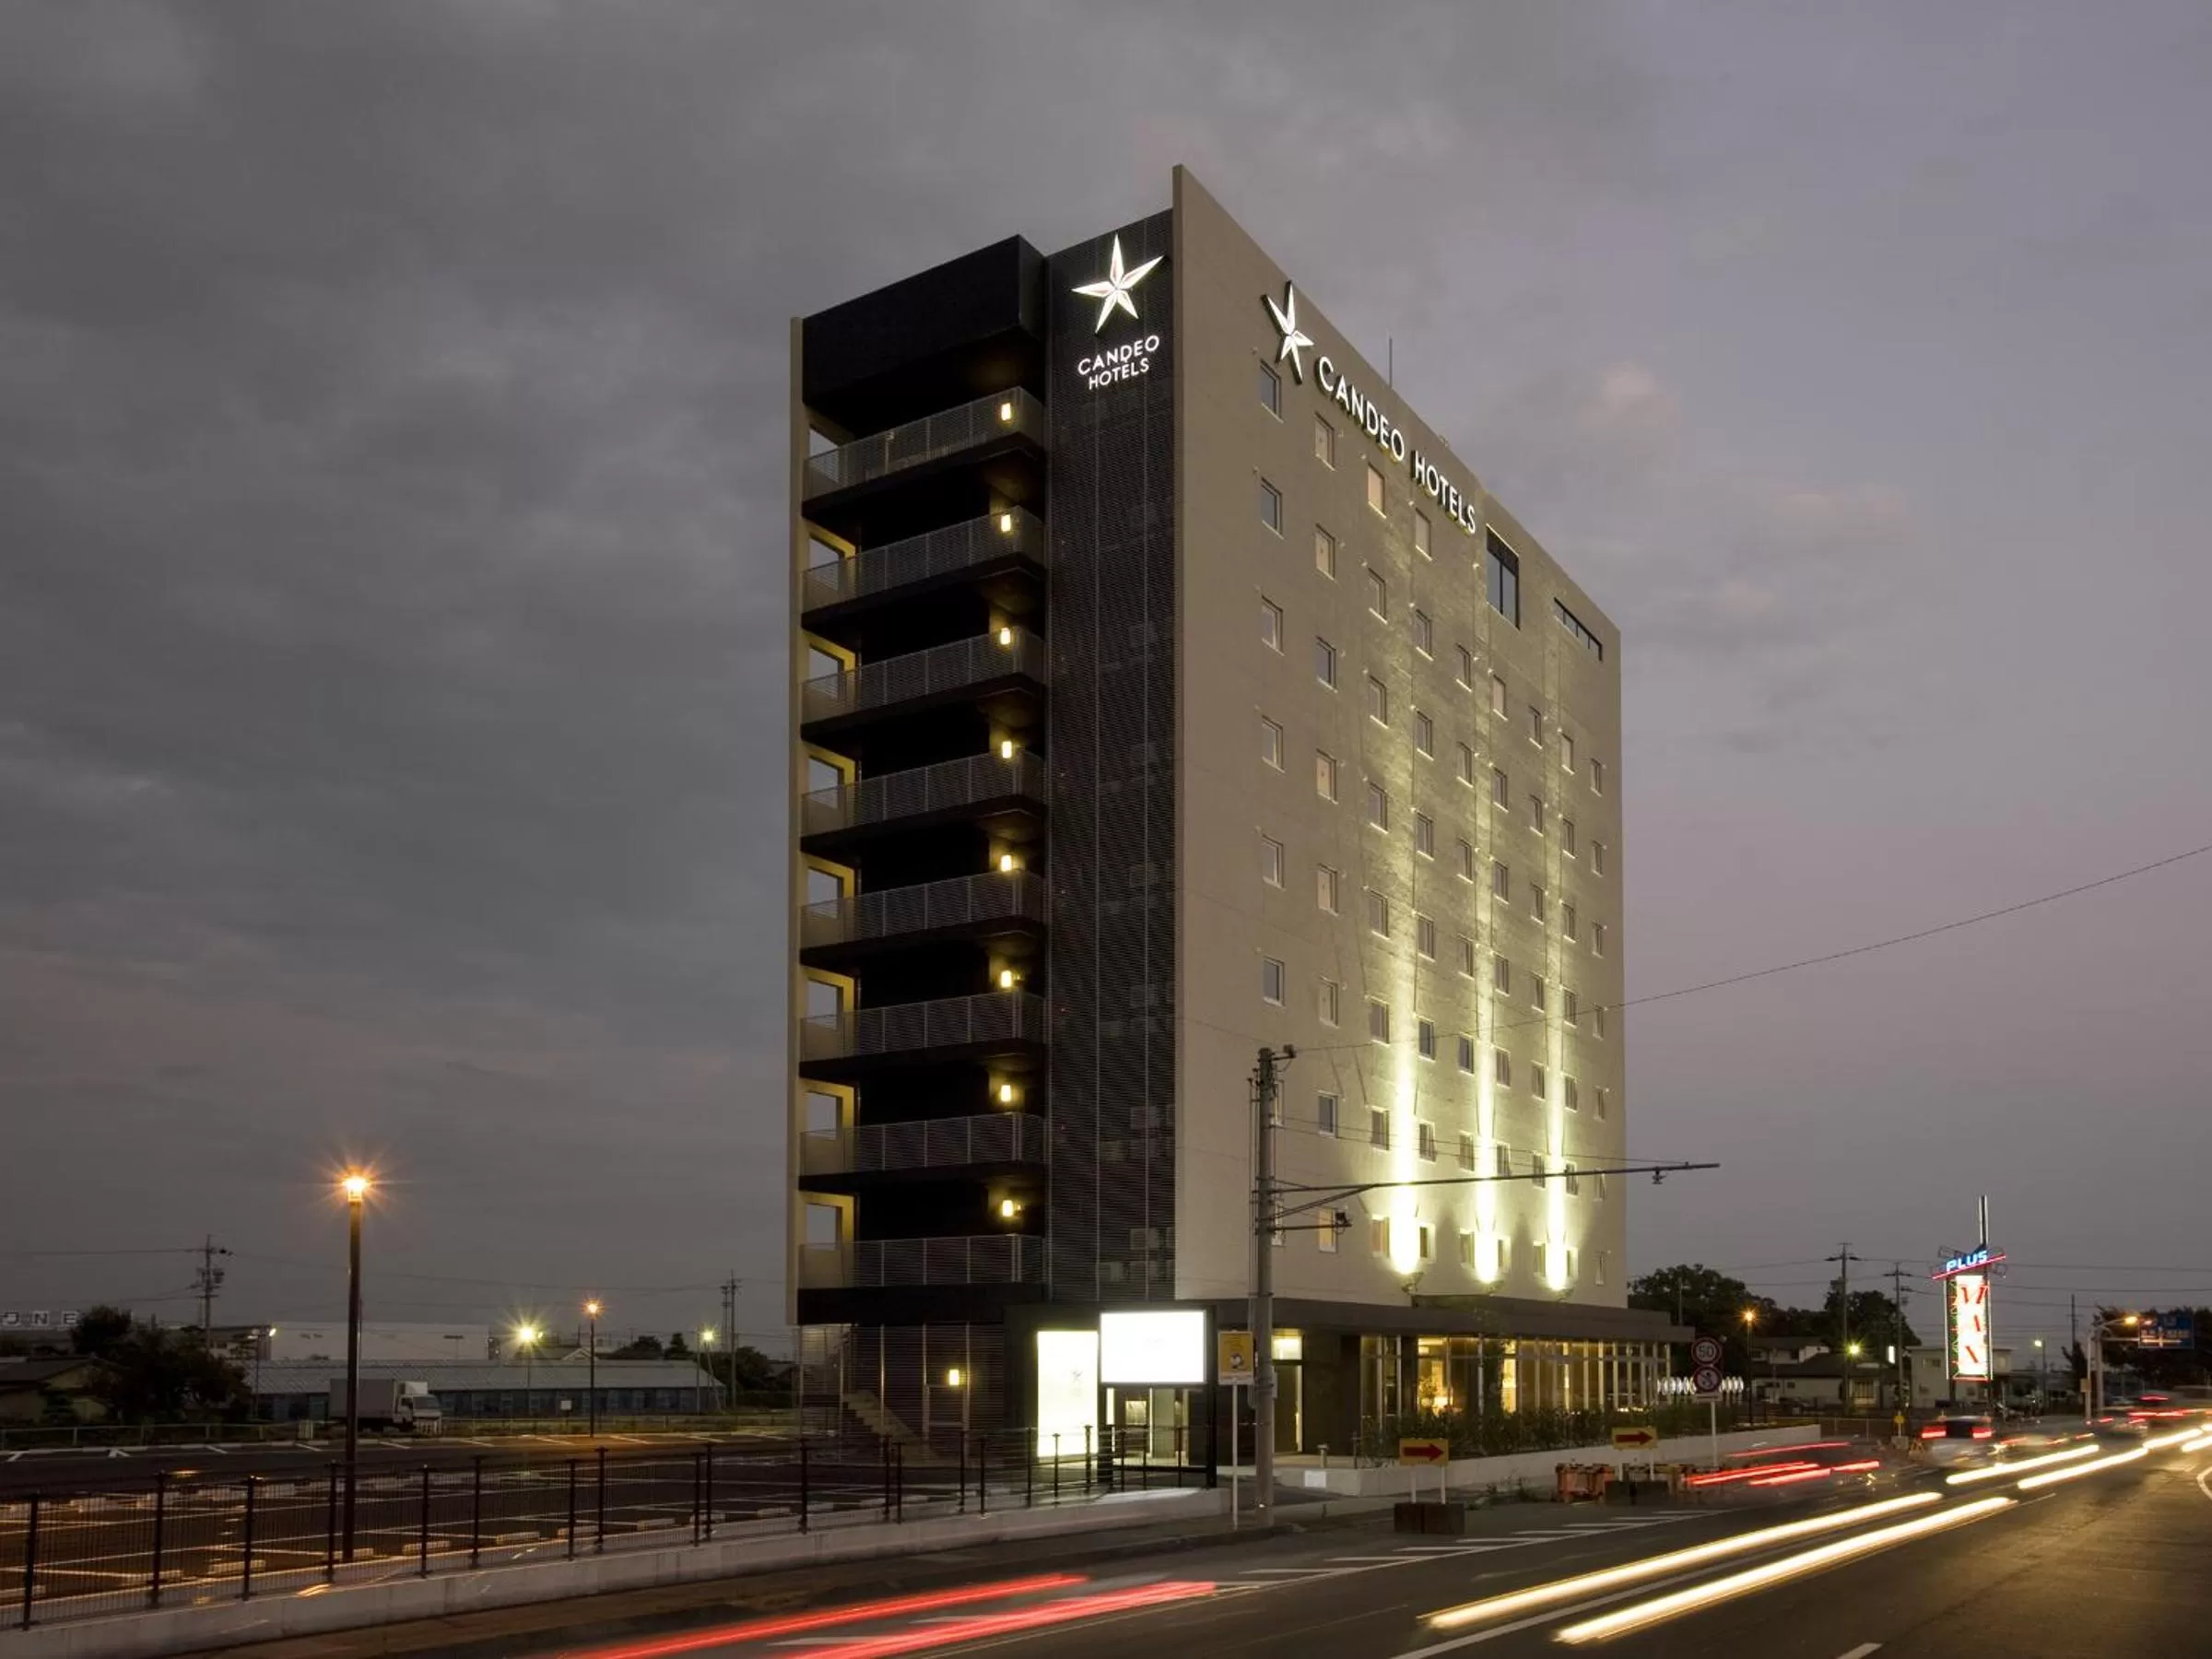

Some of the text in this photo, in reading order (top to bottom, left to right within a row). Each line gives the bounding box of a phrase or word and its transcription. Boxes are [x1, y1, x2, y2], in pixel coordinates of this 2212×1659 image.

[1077, 335, 1160, 375] CANDEO
[1088, 358, 1150, 391] HOTELS
[1317, 356, 1476, 535] CANDEO HOTELS
[1946, 1250, 1989, 1272] PLUS
